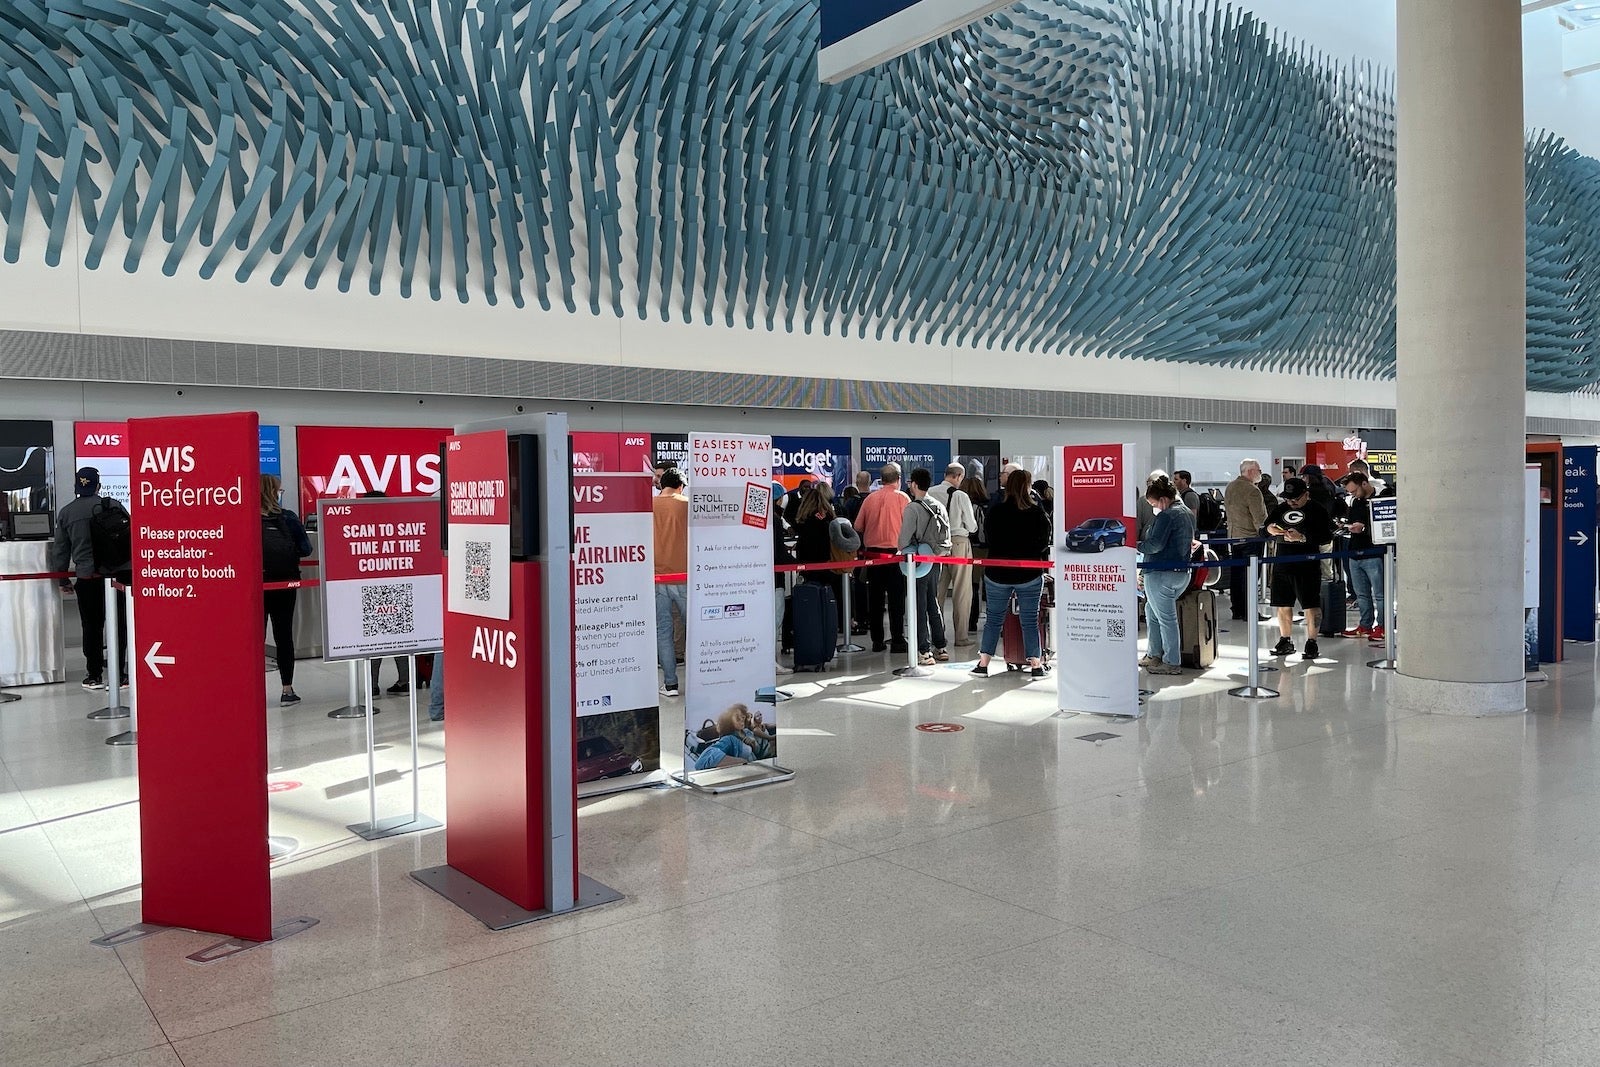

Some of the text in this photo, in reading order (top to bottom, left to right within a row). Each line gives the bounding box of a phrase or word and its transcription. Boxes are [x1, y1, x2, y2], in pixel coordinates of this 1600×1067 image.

[84, 434, 120, 446] AVIS
[449, 441, 461, 451] AVIS
[625, 438, 644, 446] AVIS
[657, 442, 688, 450] GET THE R
[694, 439, 770, 450] EASIEST WAY
[140, 446, 195, 473] AVIS
[657, 451, 688, 459] PROTECTI
[694, 453, 736, 462] TO PAY
[772, 448, 832, 473] Budget
[1378, 454, 1392, 463] FOX
[1072, 456, 1113, 472] AVIS
[325, 454, 440, 494] AVIS
[694, 468, 767, 477] YOUR TOLLS
[1565, 466, 1586, 476] eak
[141, 476, 241, 506] Preferred
[451, 480, 504, 500] SCAN QR CODE TO
[573, 486, 604, 502] VIS
[693, 494, 723, 503] E-TOLL
[327, 506, 351, 515] AVIS
[451, 499, 495, 516] CHECK-IN NOW
[693, 504, 740, 512] UNLIMITED
[140, 525, 223, 543] Please proceed
[343, 523, 426, 538] SCAN TO SAVE
[574, 526, 590, 543] ME
[141, 549, 154, 562] up
[157, 545, 206, 558] escalator
[350, 540, 420, 555] TIME AT THE
[578, 545, 646, 564] AIRLINES
[359, 557, 413, 572] COUNTER
[141, 564, 235, 578] elevator to booth
[576, 568, 604, 585] ERS
[142, 584, 196, 597] on floor 2.
[1072, 583, 1118, 592] EXPERIENCE.
[377, 606, 398, 614] AVIS
[575, 621, 623, 631] MileagePlus
[604, 632, 617, 640] you
[619, 629, 645, 639] provide
[472, 626, 517, 668] AVIS
[723, 637, 742, 645] covered
[590, 667, 614, 676] United
[615, 665, 641, 673] Airlines
